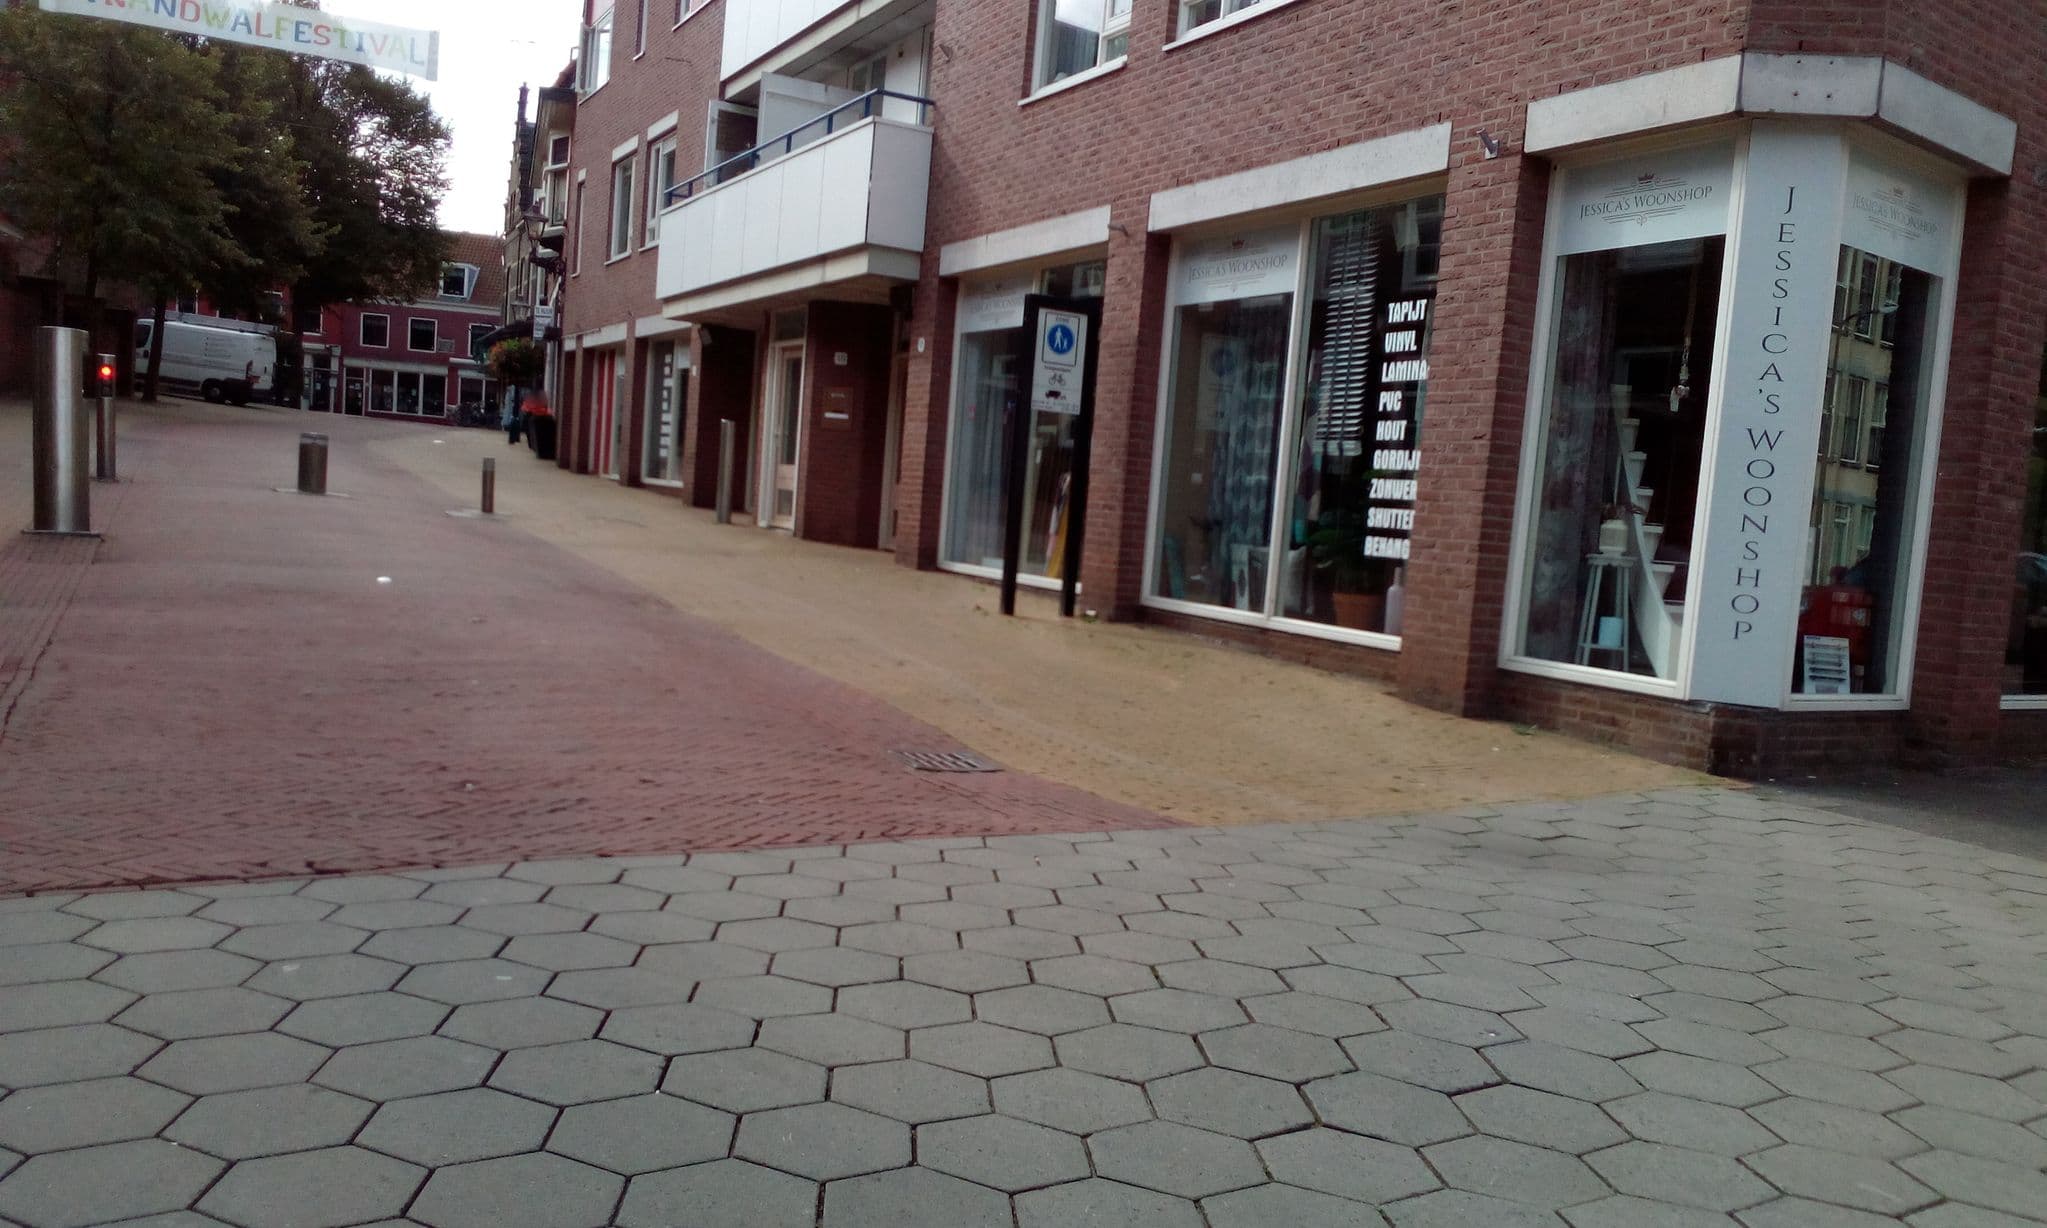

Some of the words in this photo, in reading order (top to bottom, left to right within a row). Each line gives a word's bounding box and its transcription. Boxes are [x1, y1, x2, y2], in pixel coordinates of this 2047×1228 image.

[1579, 197, 1631, 222] JESSICA'S
[1634, 185, 1713, 209] WOONSHOP
[1388, 299, 1428, 323] TAPIJT
[1757, 185, 1797, 416] JESSICA'S
[1381, 360, 1431, 383] LAMINA
[1375, 420, 1407, 441] HOUT
[1730, 427, 1785, 641] WOONSHOP
